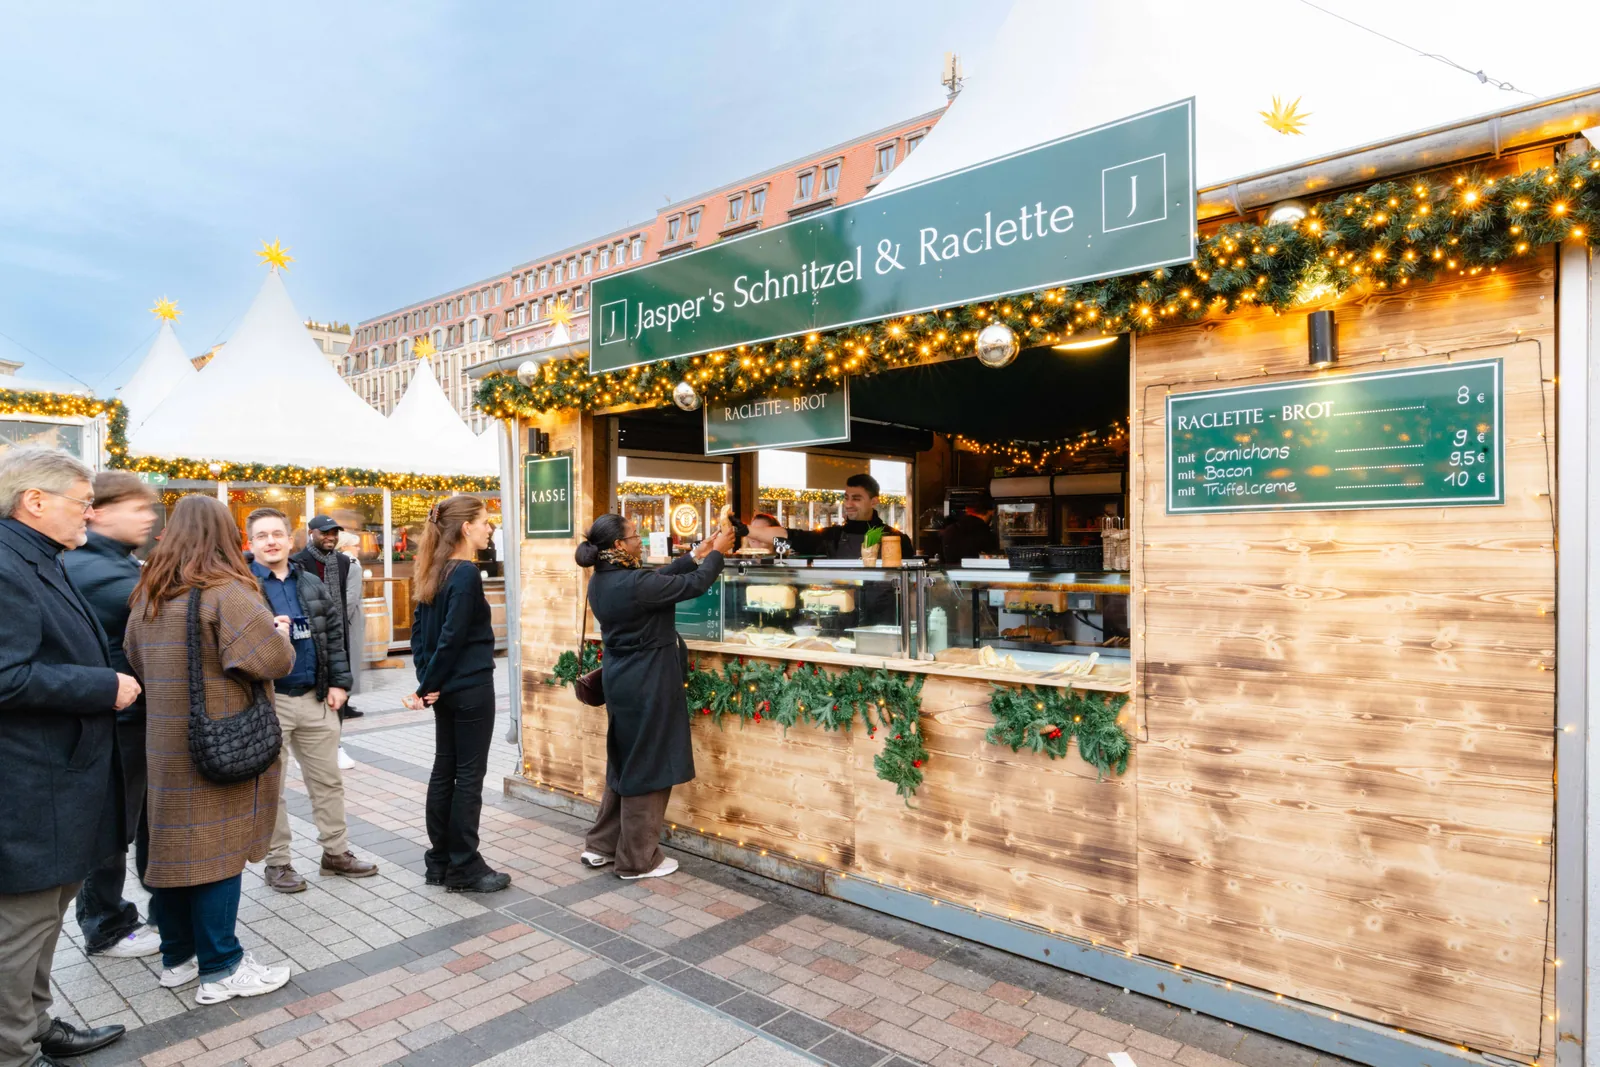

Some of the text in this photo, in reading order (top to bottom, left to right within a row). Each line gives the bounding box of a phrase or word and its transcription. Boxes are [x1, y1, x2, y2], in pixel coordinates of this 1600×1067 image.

[1126, 175, 1138, 218] J
[635, 201, 1075, 339] Jasper's Schnitzel & Raclette
[610, 310, 616, 337] J
[724, 399, 782, 422] RACLETTE
[793, 392, 828, 413] BROT
[1178, 407, 1264, 431] RACLETTE
[1282, 401, 1334, 421] BROT
[1457, 385, 1470, 404] 8
[1476, 393, 1485, 403] €
[1177, 429, 1485, 464] mit Cornichons 9 €
[1177, 470, 1196, 480] mit
[1203, 465, 1253, 481] Bacon
[1177, 471, 1486, 497] mit Trüffelcreme 10 €
[531, 488, 566, 504] KASSE
